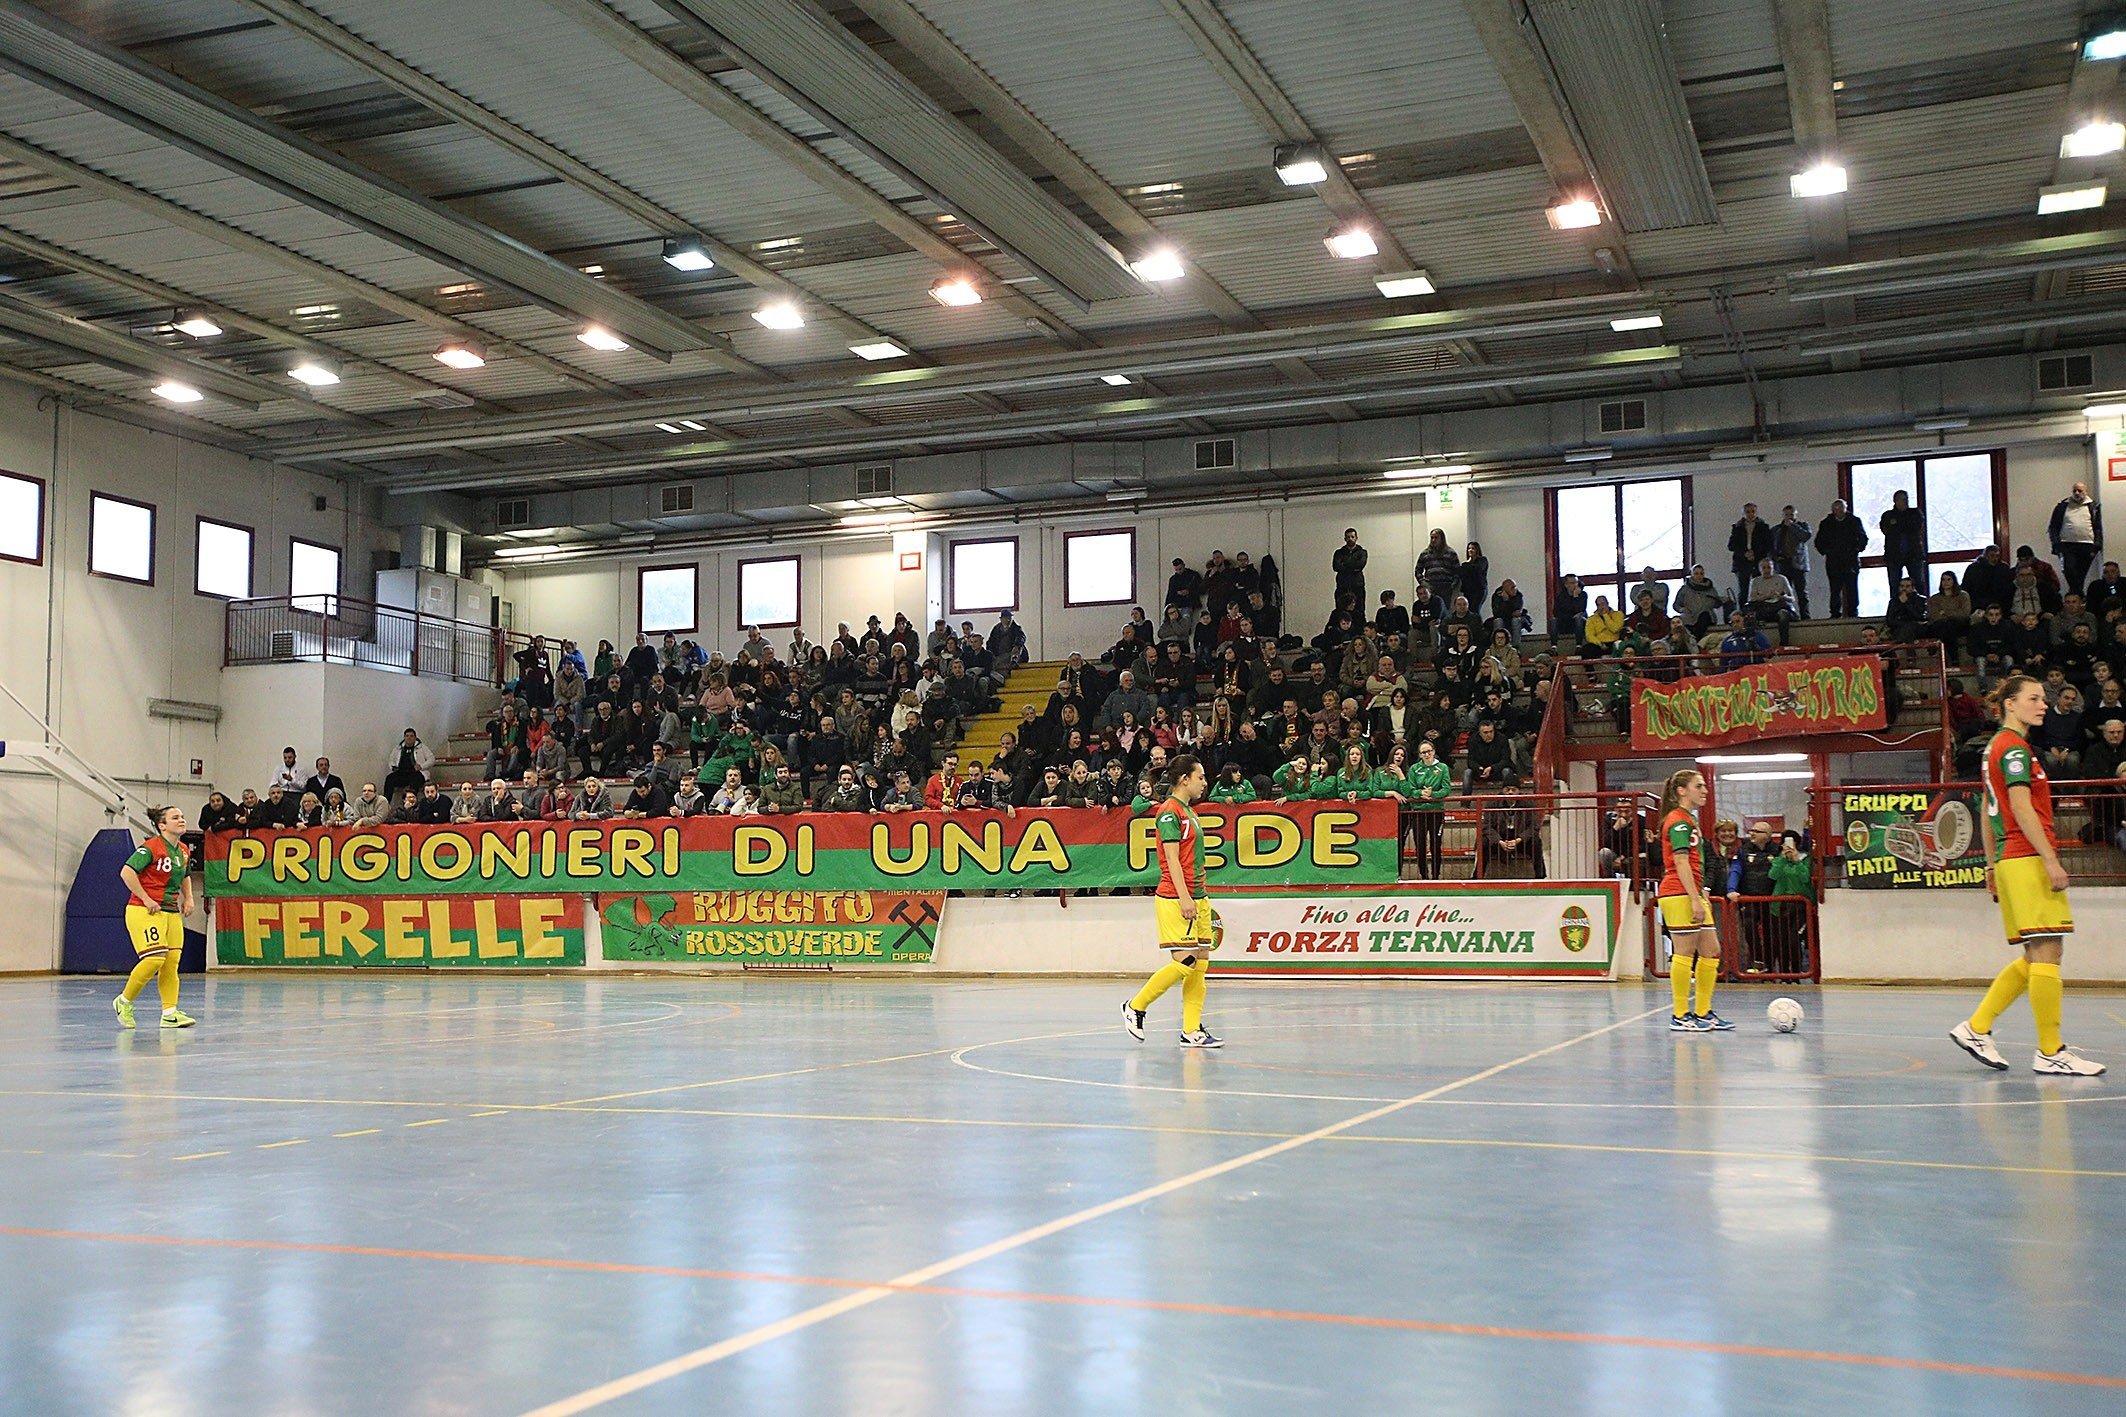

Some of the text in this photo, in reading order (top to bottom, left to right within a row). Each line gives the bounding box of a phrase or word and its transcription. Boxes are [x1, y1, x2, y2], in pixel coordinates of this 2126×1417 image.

[1844, 794, 1928, 812] GRUPPO
[1181, 819, 1190, 840] 7
[226, 827, 682, 884] PRIGIONIERI
[732, 822, 815, 877] DI
[870, 819, 1071, 876] UNA
[156, 857, 173, 872] 18
[1847, 856, 1898, 877] FIATO
[1892, 866, 1988, 887] ALLE TROMB
[693, 890, 873, 923] RUGGITO
[1300, 905, 1346, 924] Fino
[1356, 905, 1410, 924] alla
[144, 926, 160, 943] 18
[242, 897, 566, 959] FERELLE
[686, 930, 883, 957] ROSSOVERDE
[1246, 930, 1536, 954] FORZA TERNANA
